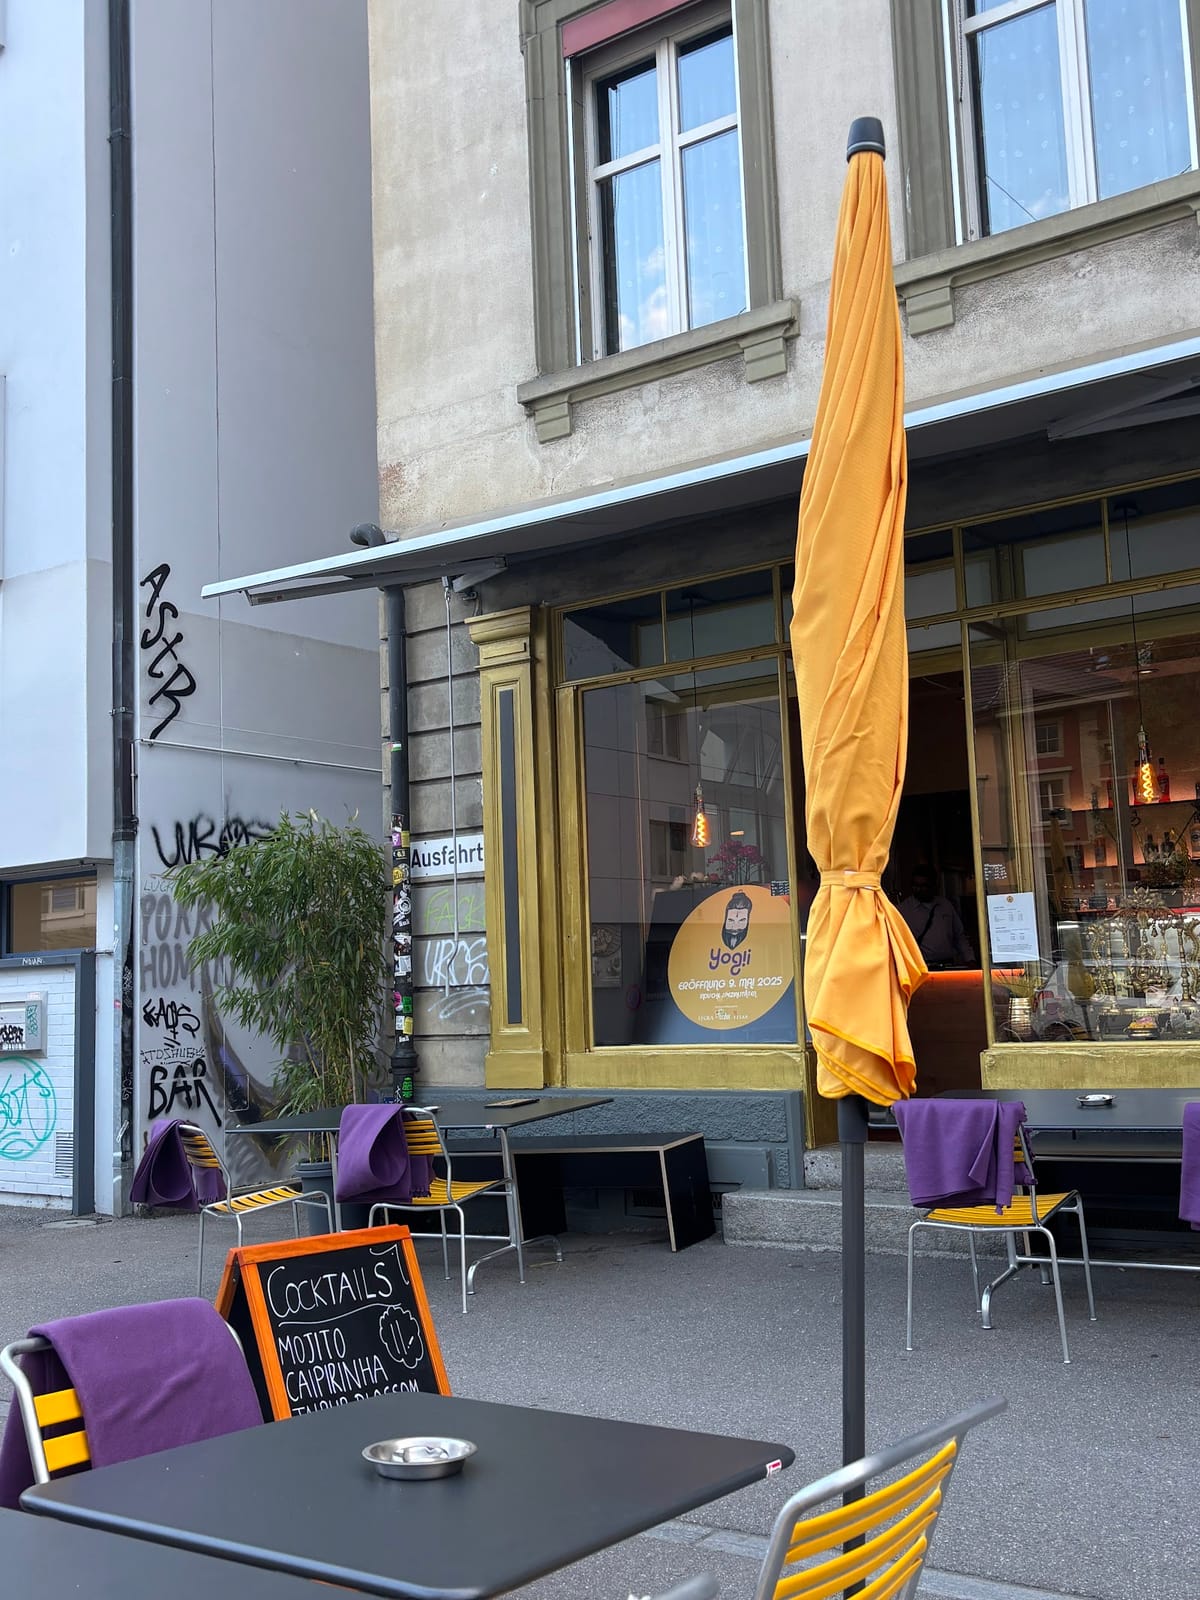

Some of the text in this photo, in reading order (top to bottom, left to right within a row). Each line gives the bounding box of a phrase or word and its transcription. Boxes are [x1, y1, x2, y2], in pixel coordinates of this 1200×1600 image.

[411, 842, 484, 868] Ausfahrt
[678, 979, 726, 991] ERÖFFNUNG
[738, 977, 755, 989] MAI
[757, 976, 783, 986] 2025
[147, 1058, 222, 1127] BAR
[266, 1261, 393, 1318] COCKTAILS
[277, 1327, 346, 1366] MOJITO
[285, 1354, 389, 1402] CAIPIRINHA
